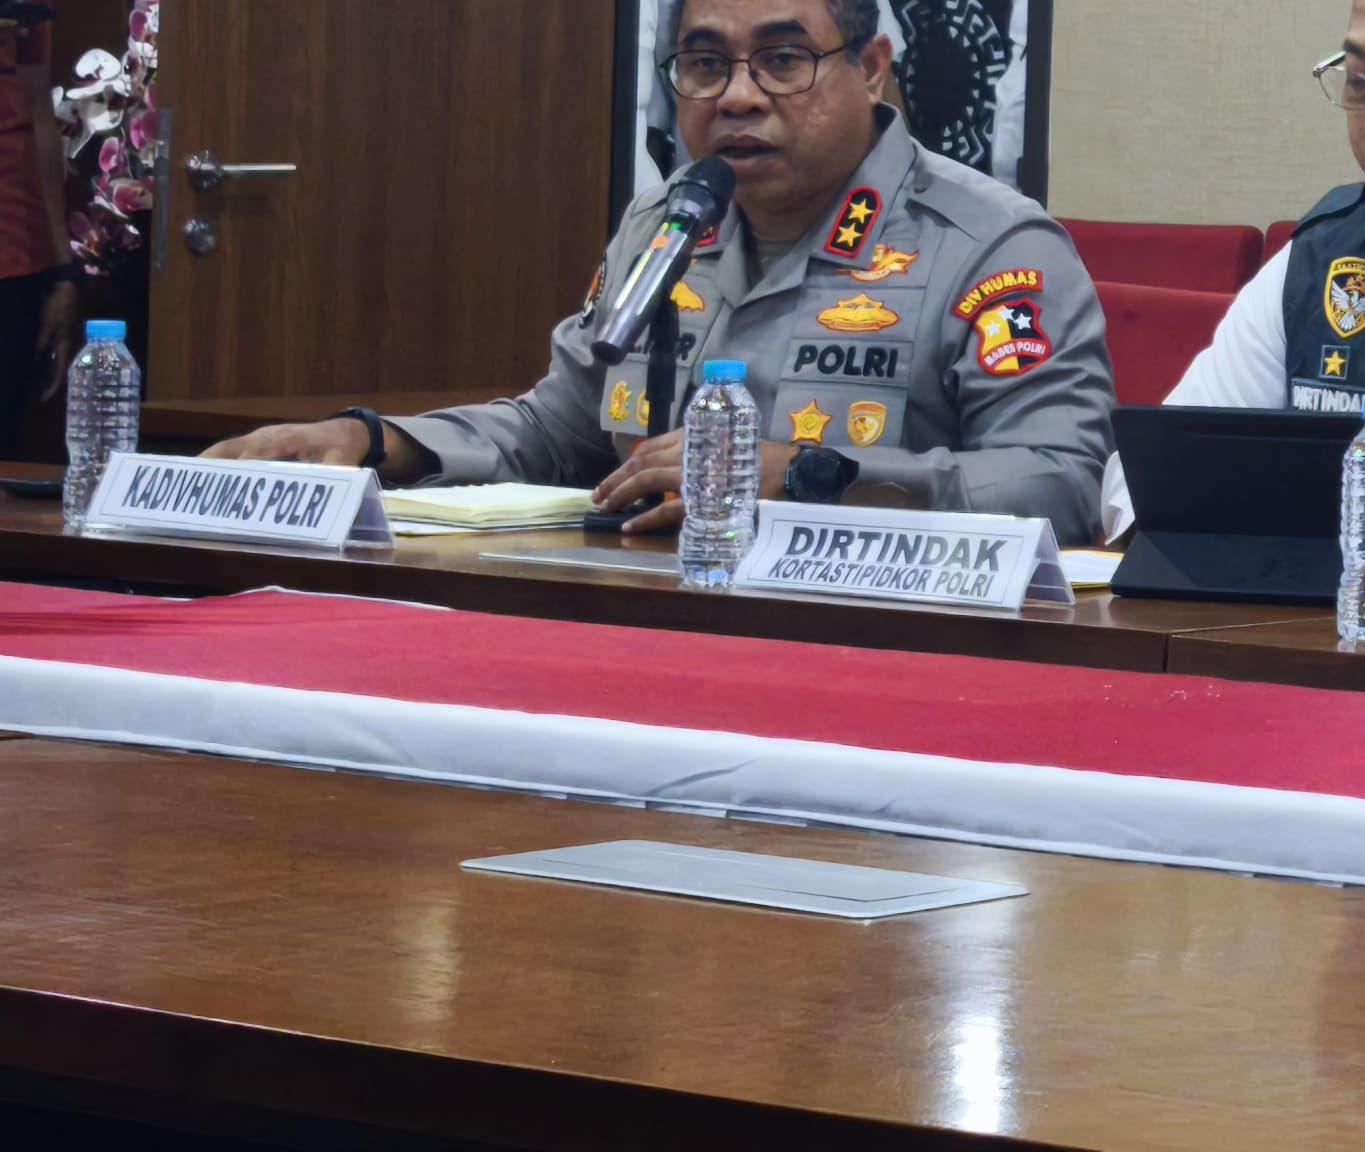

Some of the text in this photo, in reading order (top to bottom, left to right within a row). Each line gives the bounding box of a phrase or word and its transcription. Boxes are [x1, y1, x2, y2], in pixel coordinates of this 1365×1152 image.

[959, 271, 1037, 313] DIV HUMAS
[793, 345, 899, 378] POLRI
[121, 465, 334, 529] KADIVHUMAS POLRI
[786, 526, 1007, 571] DIRTINDAK
[769, 559, 993, 597] KORTASTIPIDKOR POLRI
